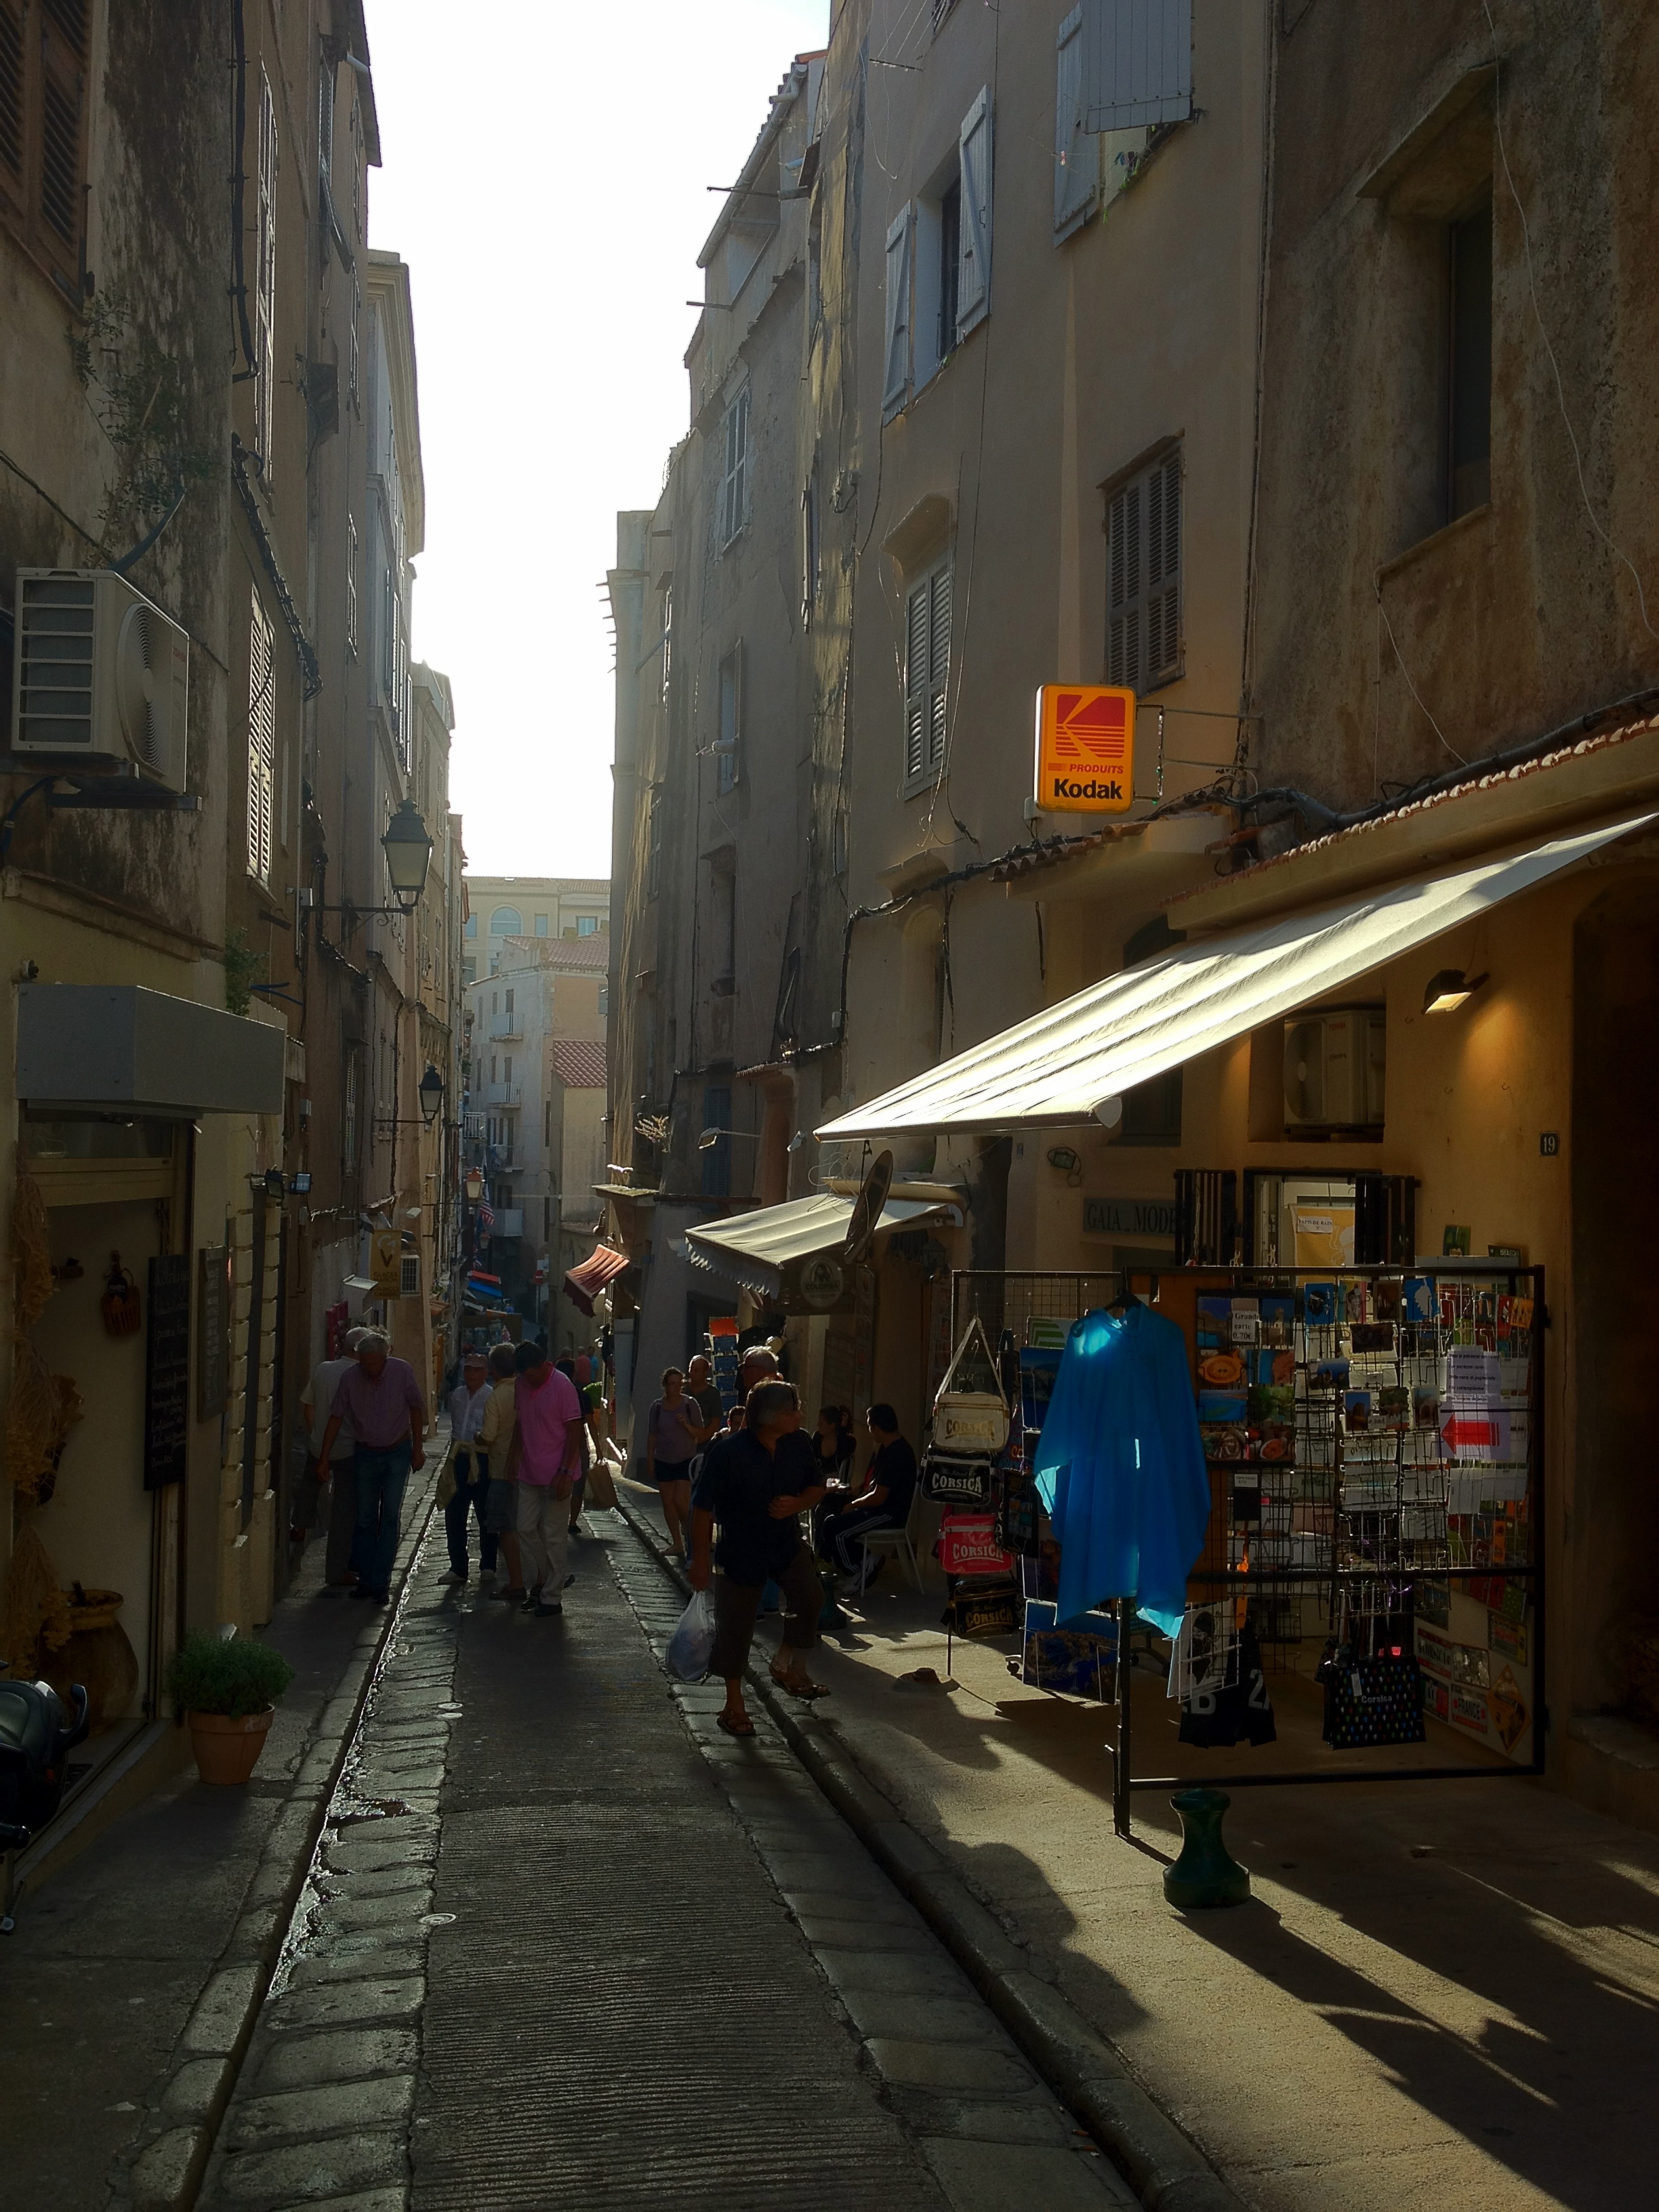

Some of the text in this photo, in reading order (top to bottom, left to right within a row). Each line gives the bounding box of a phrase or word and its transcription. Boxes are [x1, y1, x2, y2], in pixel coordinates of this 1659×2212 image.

[1069, 763, 1124, 774] PRODUITS
[1054, 778, 1123, 800] Kodak
[1543, 1136, 1555, 1153] 19
[1087, 1203, 1122, 1231] GAIA
[946, 1418, 995, 1437] CORSICA
[932, 1472, 982, 1494] CORSICA
[953, 1542, 1004, 1559] CORSICA
[966, 1605, 1013, 1629] CORSICA
[1361, 1695, 1393, 1704] Corsica
[1458, 1697, 1481, 1720] FRANCE
